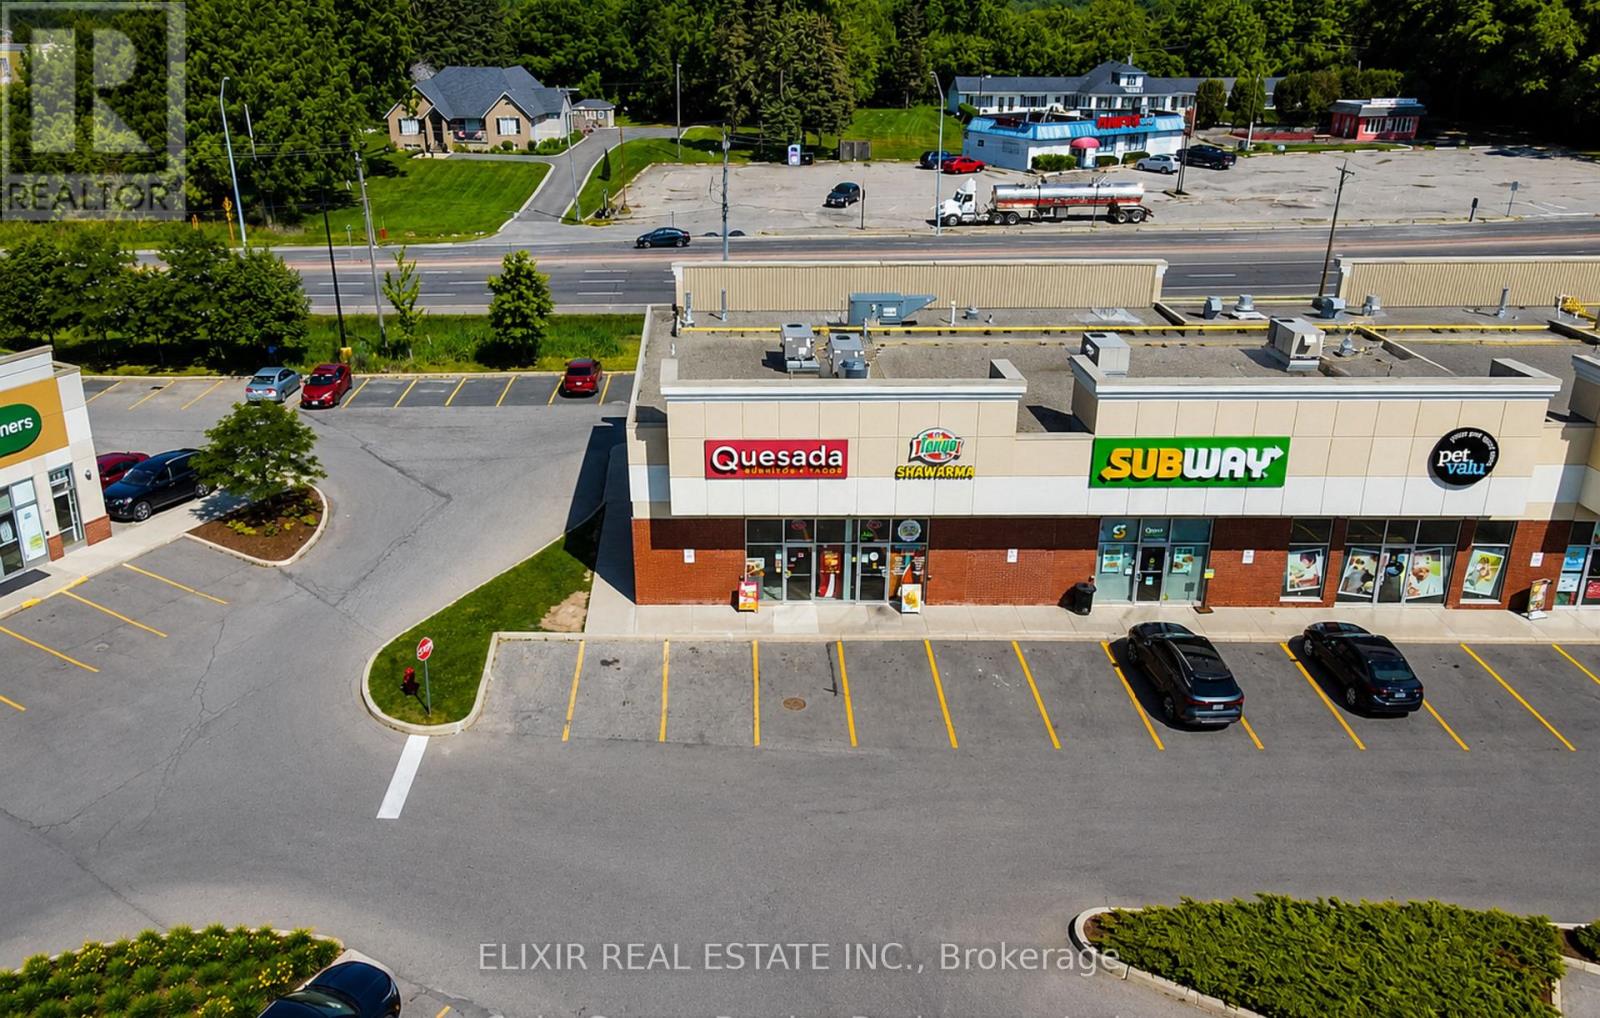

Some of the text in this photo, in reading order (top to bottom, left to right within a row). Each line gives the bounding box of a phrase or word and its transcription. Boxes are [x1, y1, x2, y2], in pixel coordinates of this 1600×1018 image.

[0, 417, 34, 437] ners
[712, 445, 842, 471] Quesada
[1101, 446, 1285, 480] SUBWAY
[1437, 449, 1471, 467] pet
[1446, 459, 1485, 475] valu
[896, 466, 975, 479] SHAWARMA
